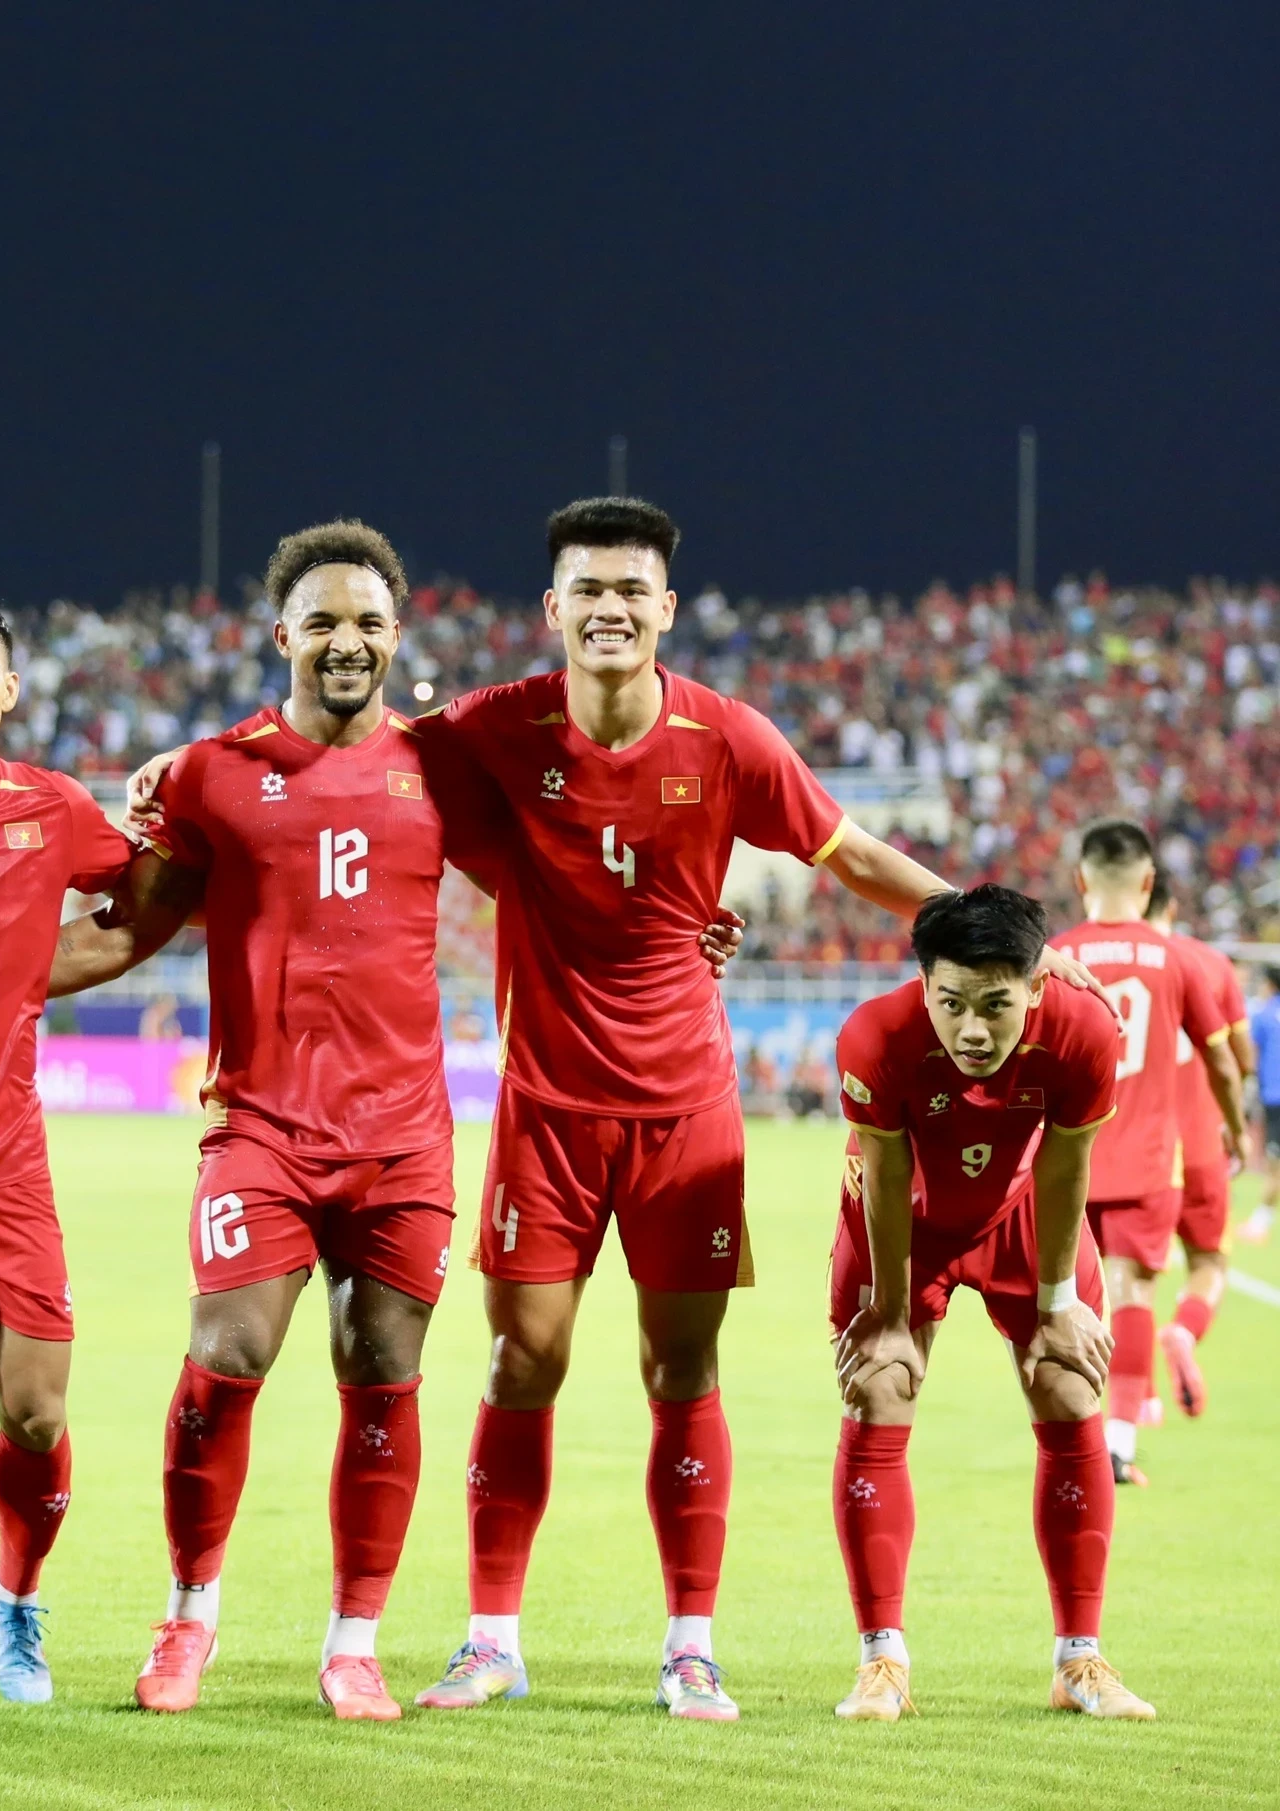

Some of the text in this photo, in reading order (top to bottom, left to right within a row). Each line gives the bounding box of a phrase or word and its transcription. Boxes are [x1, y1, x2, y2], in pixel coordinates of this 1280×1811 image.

[319, 827, 369, 900] 12
[601, 823, 636, 889] 4
[961, 1142, 993, 1179] 9
[199, 1192, 251, 1265] 12
[492, 1183, 520, 1253] 4
